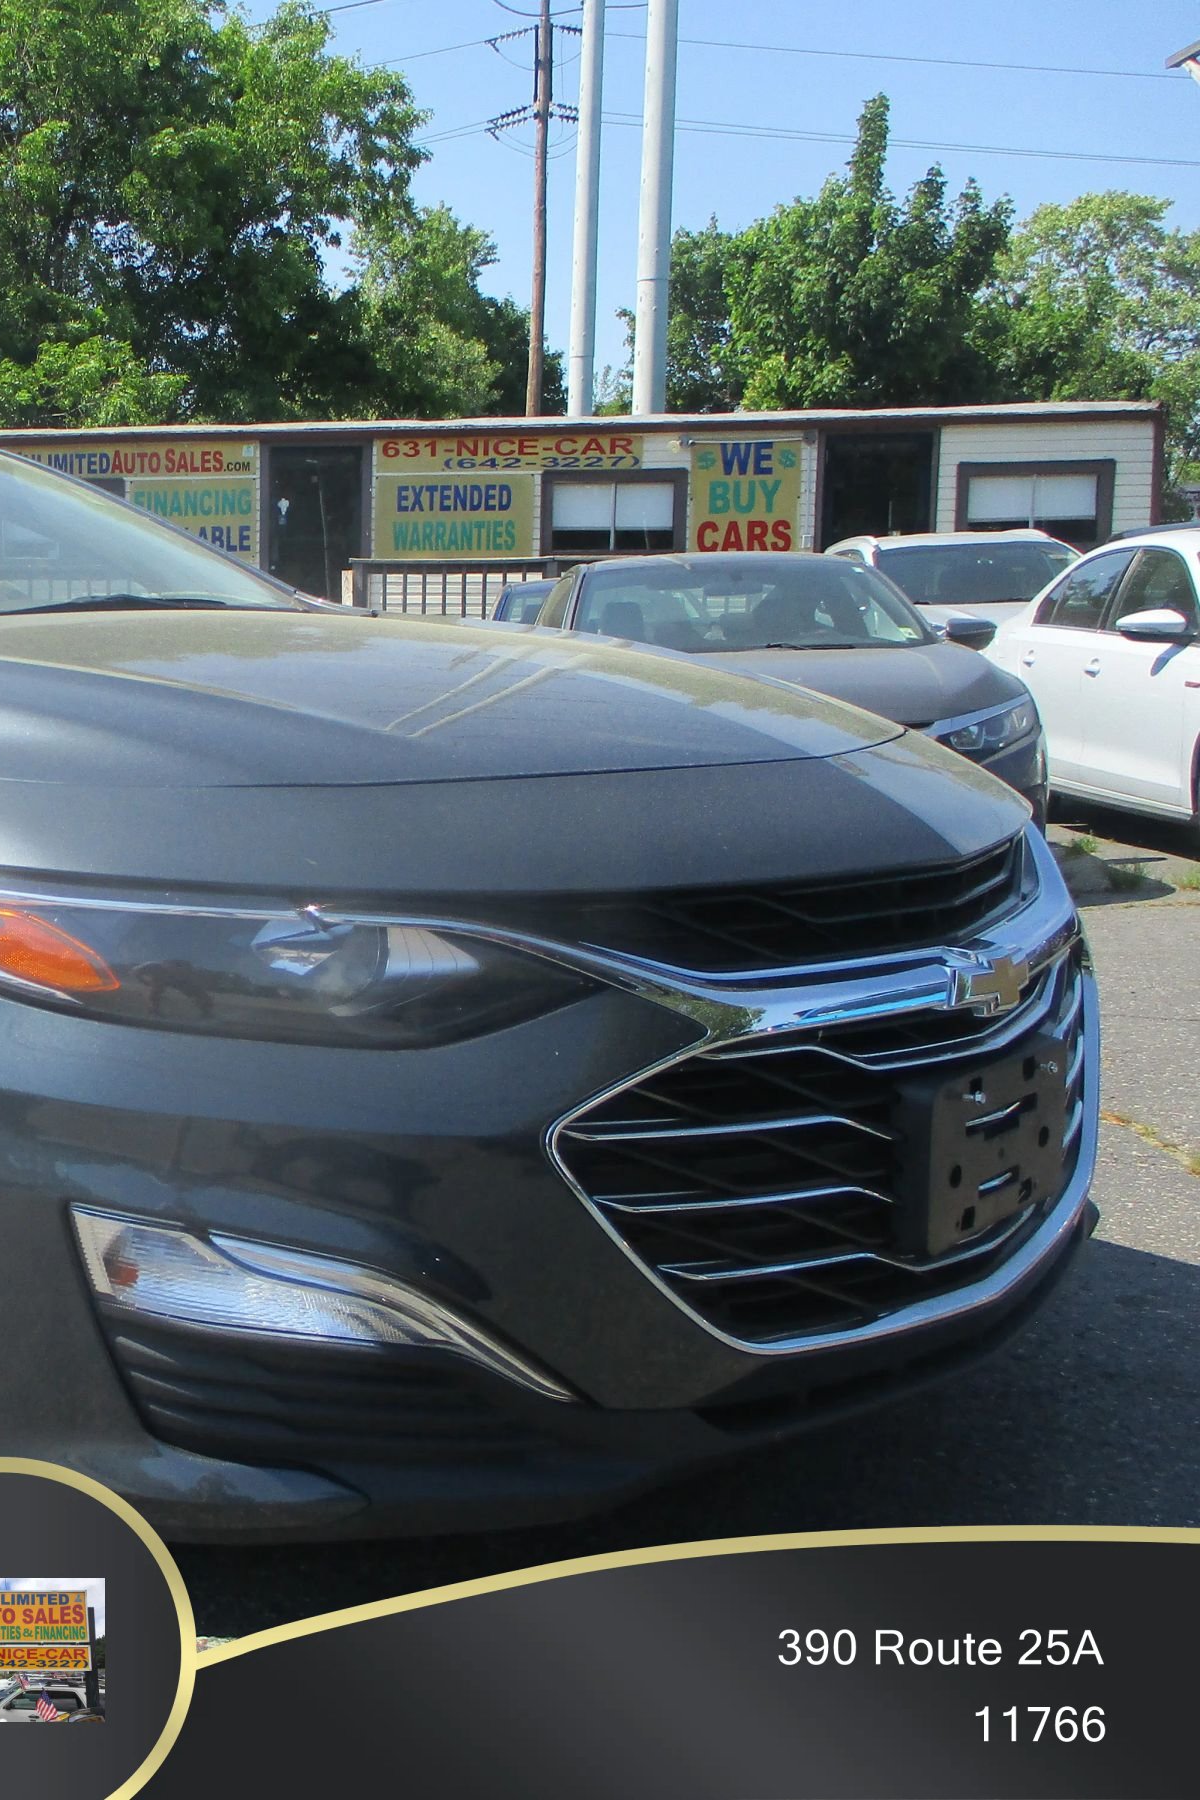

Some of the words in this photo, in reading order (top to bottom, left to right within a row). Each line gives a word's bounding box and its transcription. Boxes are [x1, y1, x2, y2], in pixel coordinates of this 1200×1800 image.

[382, 437, 633, 458] 631-NICE-CAR
[443, 455, 641, 470] (642-3227)
[720, 441, 774, 476] WE
[133, 488, 252, 517] FINANCING
[396, 483, 513, 512] EXTENDED
[708, 479, 783, 515] BUY
[392, 518, 517, 551] WARRANTIES
[696, 519, 793, 552] CARS
